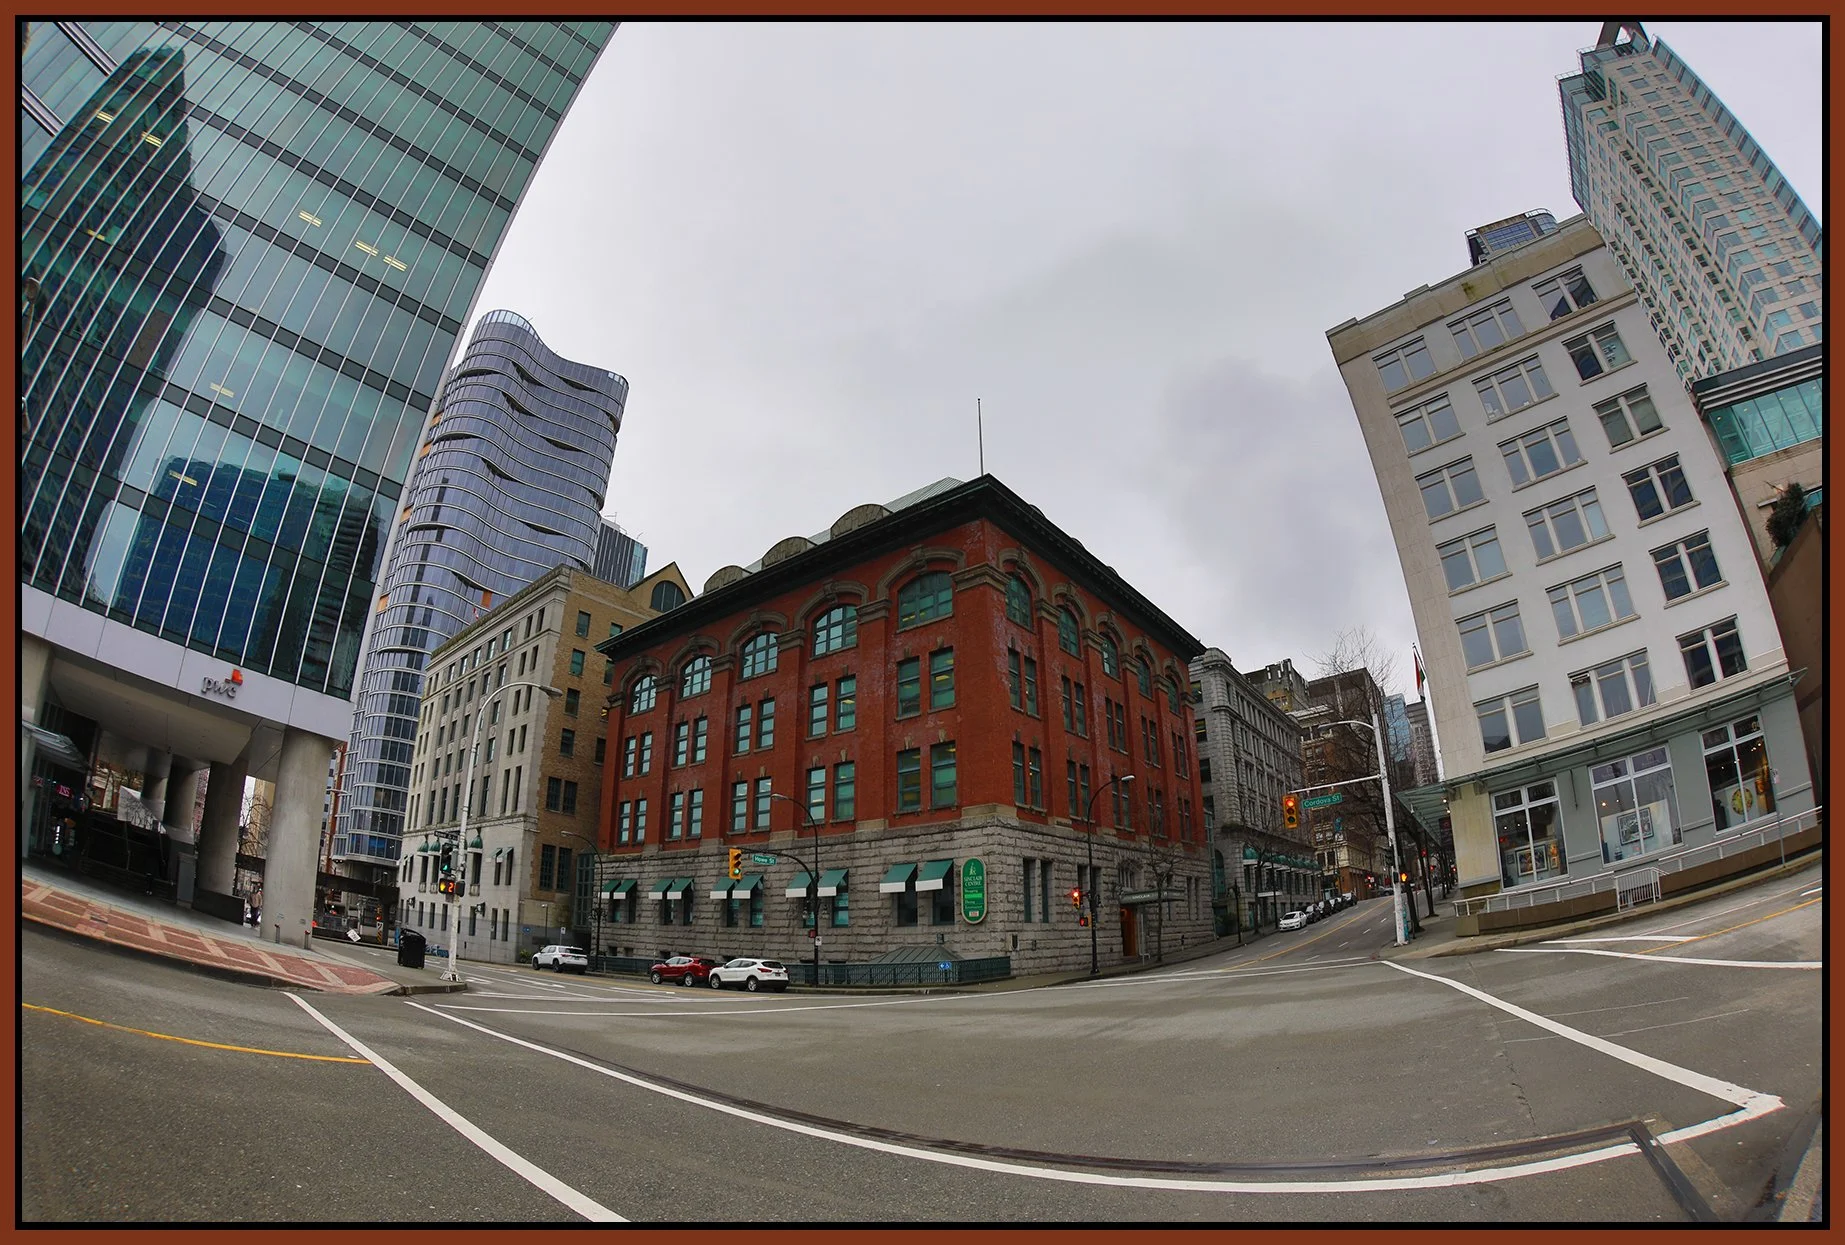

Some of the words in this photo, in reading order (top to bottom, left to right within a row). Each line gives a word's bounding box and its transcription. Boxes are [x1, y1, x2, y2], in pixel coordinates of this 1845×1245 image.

[201, 676, 236, 699] pwc
[1304, 797, 1331, 808] Cordova
[1331, 794, 1340, 803] St
